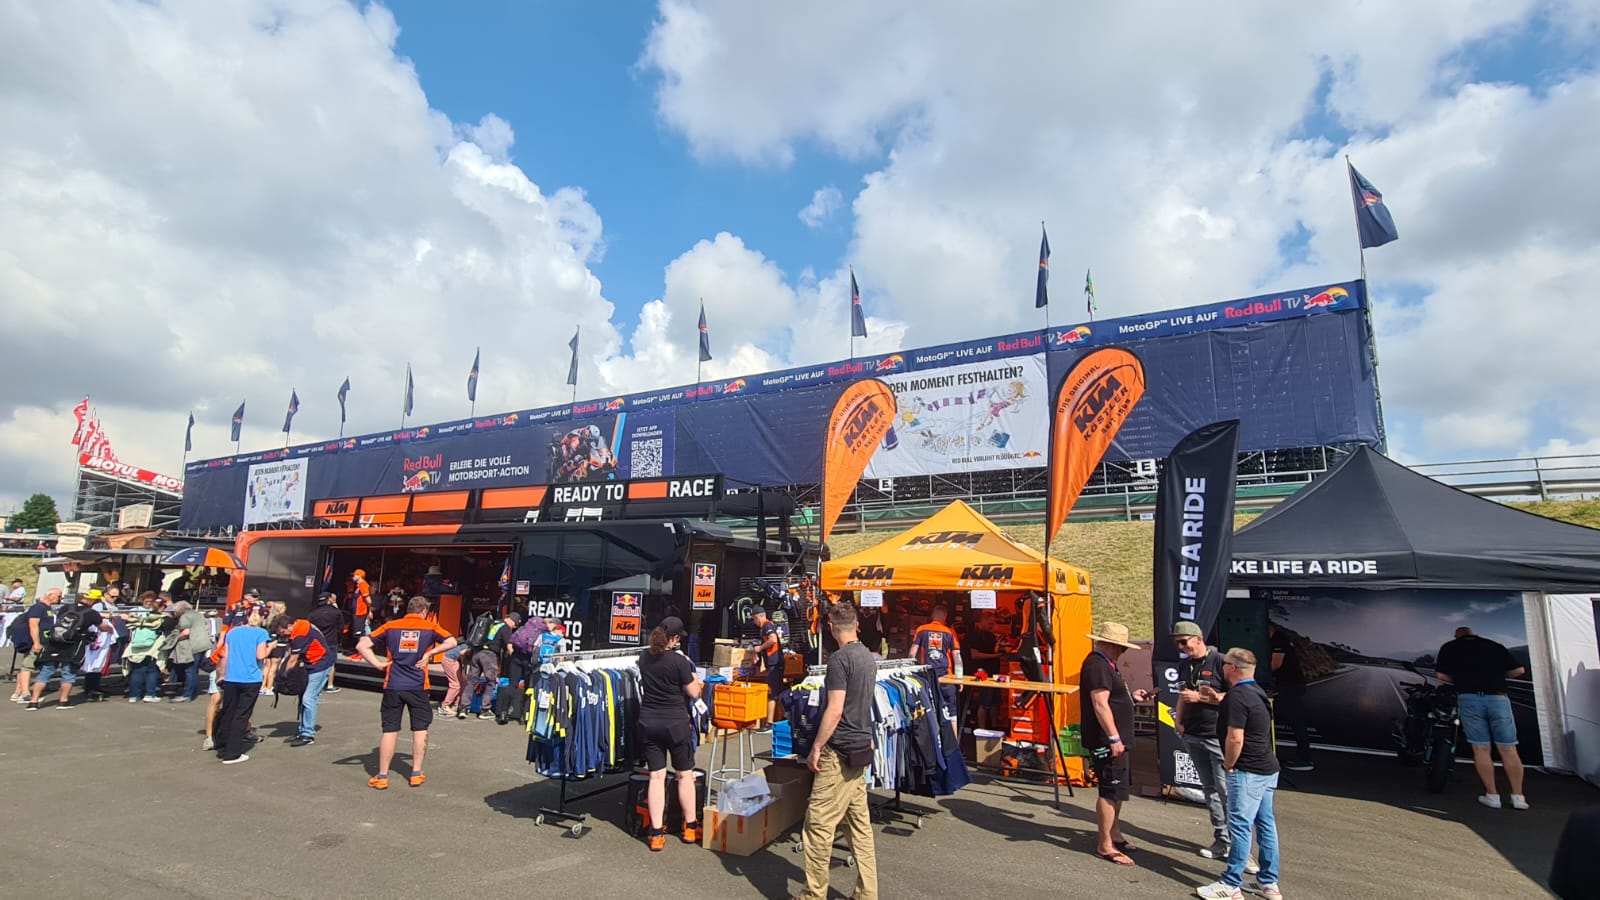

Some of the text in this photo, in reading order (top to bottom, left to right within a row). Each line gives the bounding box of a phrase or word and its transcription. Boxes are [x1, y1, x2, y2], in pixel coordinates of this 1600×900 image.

[1170, 316, 1193, 327] LIVE
[1195, 311, 1218, 323] AUF
[1283, 297, 1301, 309] TV
[956, 348, 974, 358] LIVE
[976, 345, 993, 355] AUF
[795, 372, 810, 382] LIVE
[811, 370, 825, 379] AUF
[864, 360, 875, 370] TV
[910, 375, 955, 390] MOMENT
[957, 365, 1024, 386] FESTHALTEN?
[1069, 364, 1101, 396] ORIGINAL
[658, 394, 670, 402] LIVE
[671, 392, 683, 400] AUF
[1074, 374, 1122, 434] KTM
[843, 400, 880, 448] KTM
[86, 456, 140, 478] MOTUL
[474, 458, 488, 468] DIE
[488, 455, 512, 466] VOLLE
[1141, 461, 1152, 472] E
[429, 470, 442, 485] TV
[448, 465, 530, 482] MOTORSPORT-ACTION
[553, 479, 715, 504] READY TO RACE
[883, 480, 890, 489] E
[325, 500, 349, 514] KTM
[905, 530, 985, 545] KTM
[1179, 477, 1206, 620] LIFE A RIDE
[848, 564, 895, 580] KTM
[960, 563, 1014, 580] KTM
[1262, 560, 1304, 574] LIFE
[1308, 560, 1324, 574] A
[1327, 560, 1378, 574] RIDE
[844, 578, 893, 588] RACING
[956, 578, 1012, 588] RACING
[697, 589, 711, 598] KTM
[528, 600, 575, 618] READY
[564, 621, 582, 638] TO
[616, 620, 635, 631] KTM
[564, 640, 581, 652] CE
